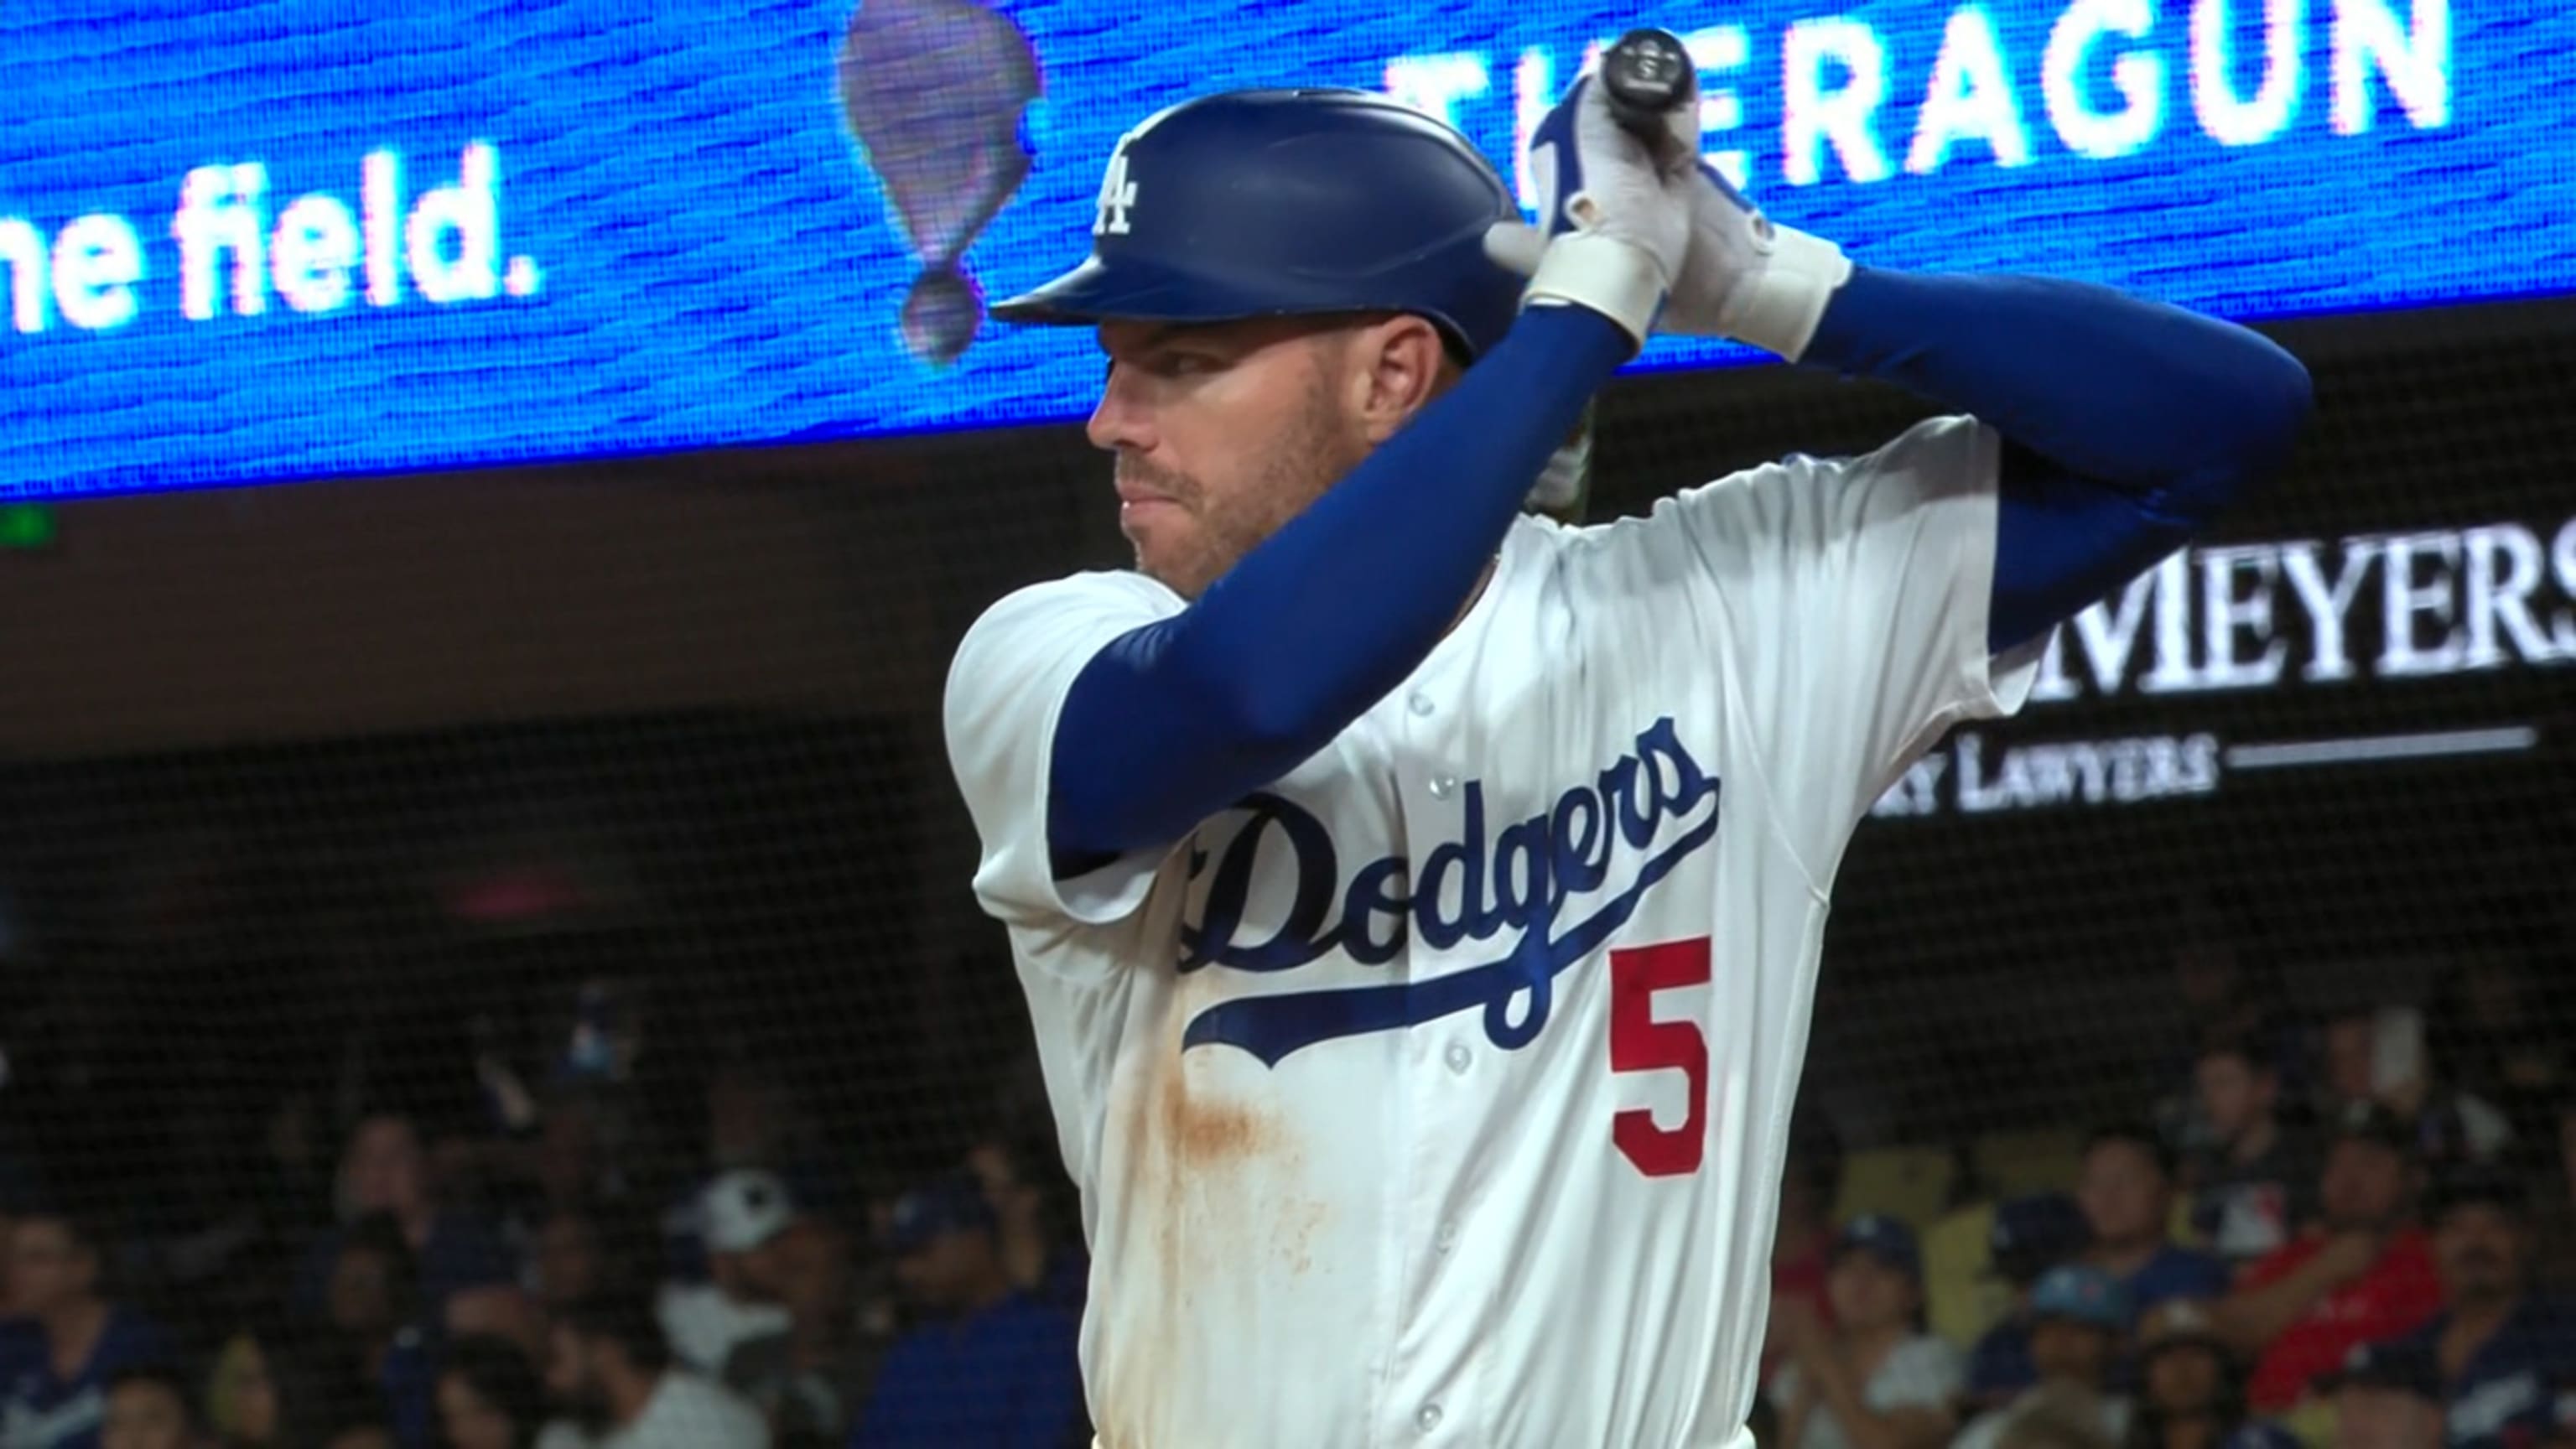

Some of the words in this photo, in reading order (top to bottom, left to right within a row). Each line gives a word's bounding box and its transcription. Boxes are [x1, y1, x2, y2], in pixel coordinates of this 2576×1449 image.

[173, 138, 543, 320] field.
[1955, 731, 2219, 812] LAWYERS
[1175, 717, 1721, 1050] Dodgers
[1609, 936, 1711, 1177] 5
